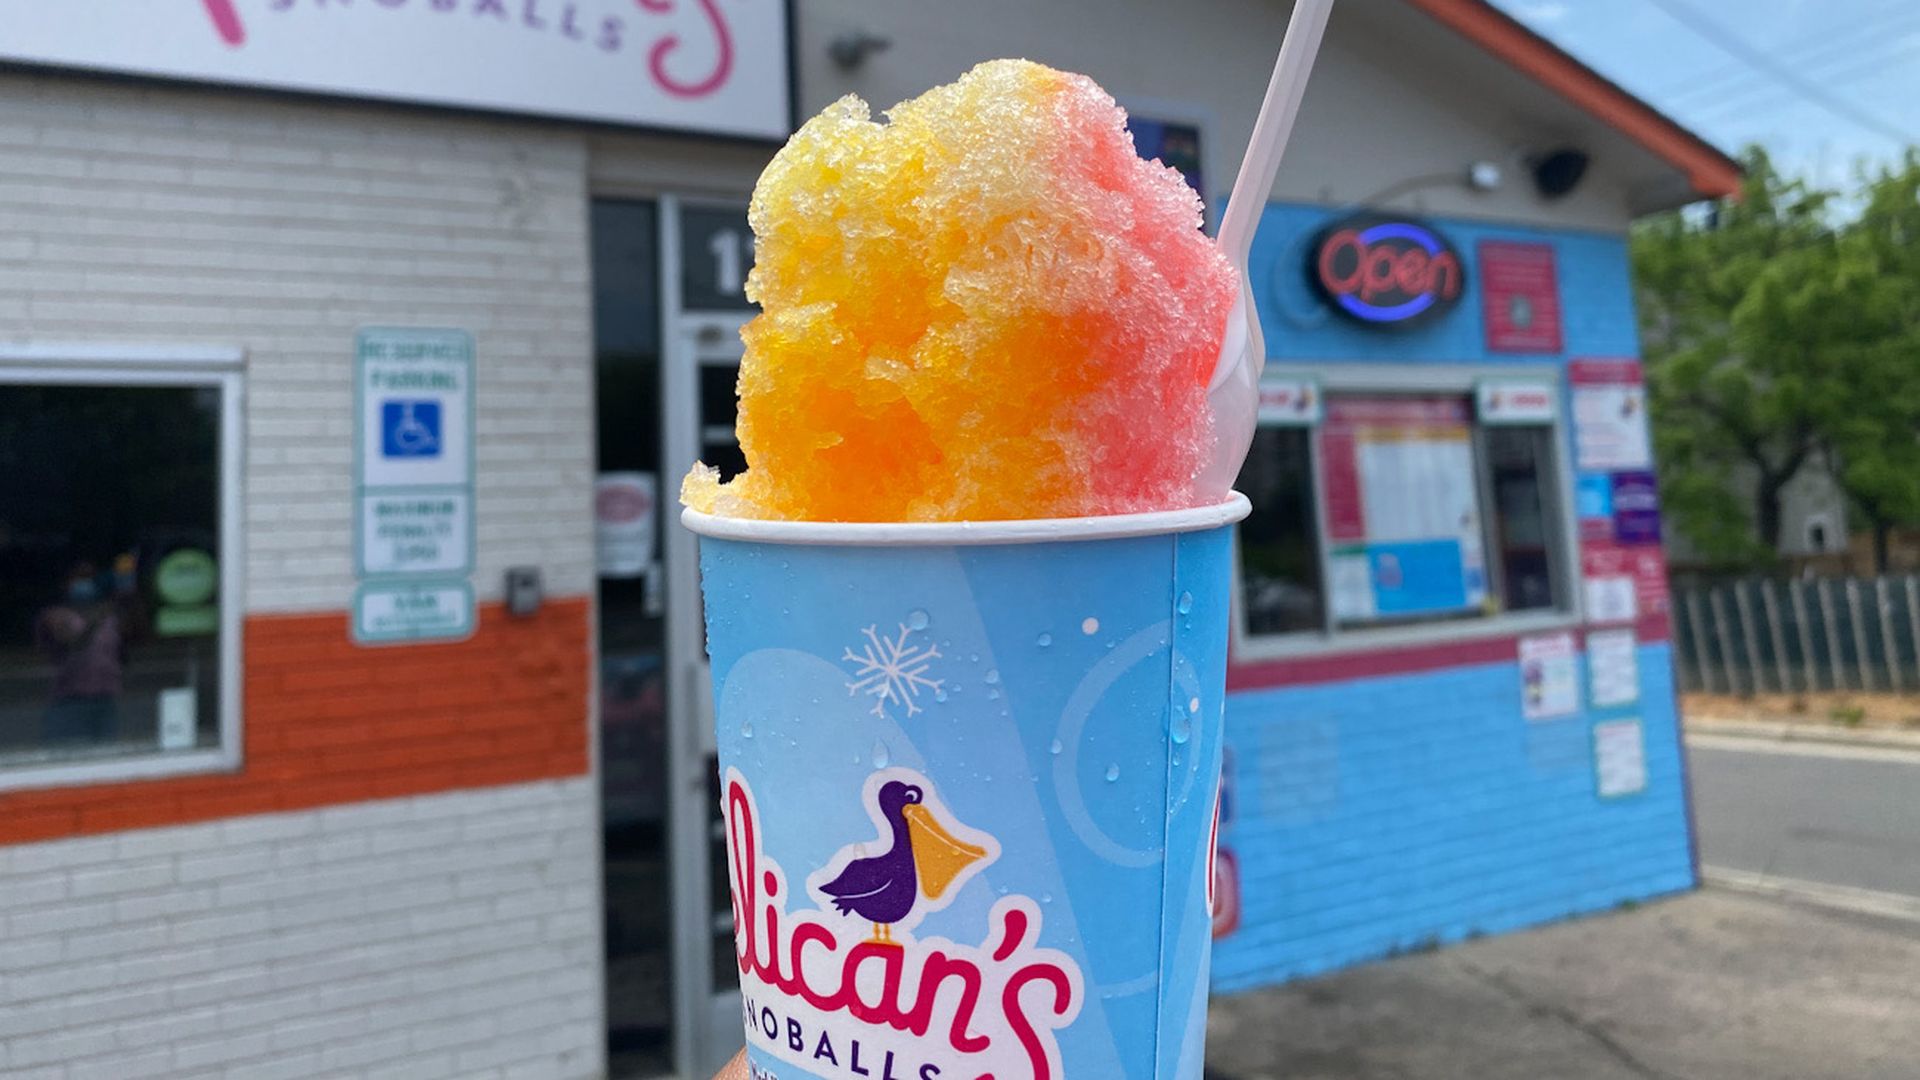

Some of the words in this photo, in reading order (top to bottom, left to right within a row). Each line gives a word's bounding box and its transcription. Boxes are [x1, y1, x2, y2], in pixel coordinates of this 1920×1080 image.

[269, 0, 626, 52] ALLS
[1318, 228, 1460, 304] Open
[744, 998, 941, 1080] NOBALL
